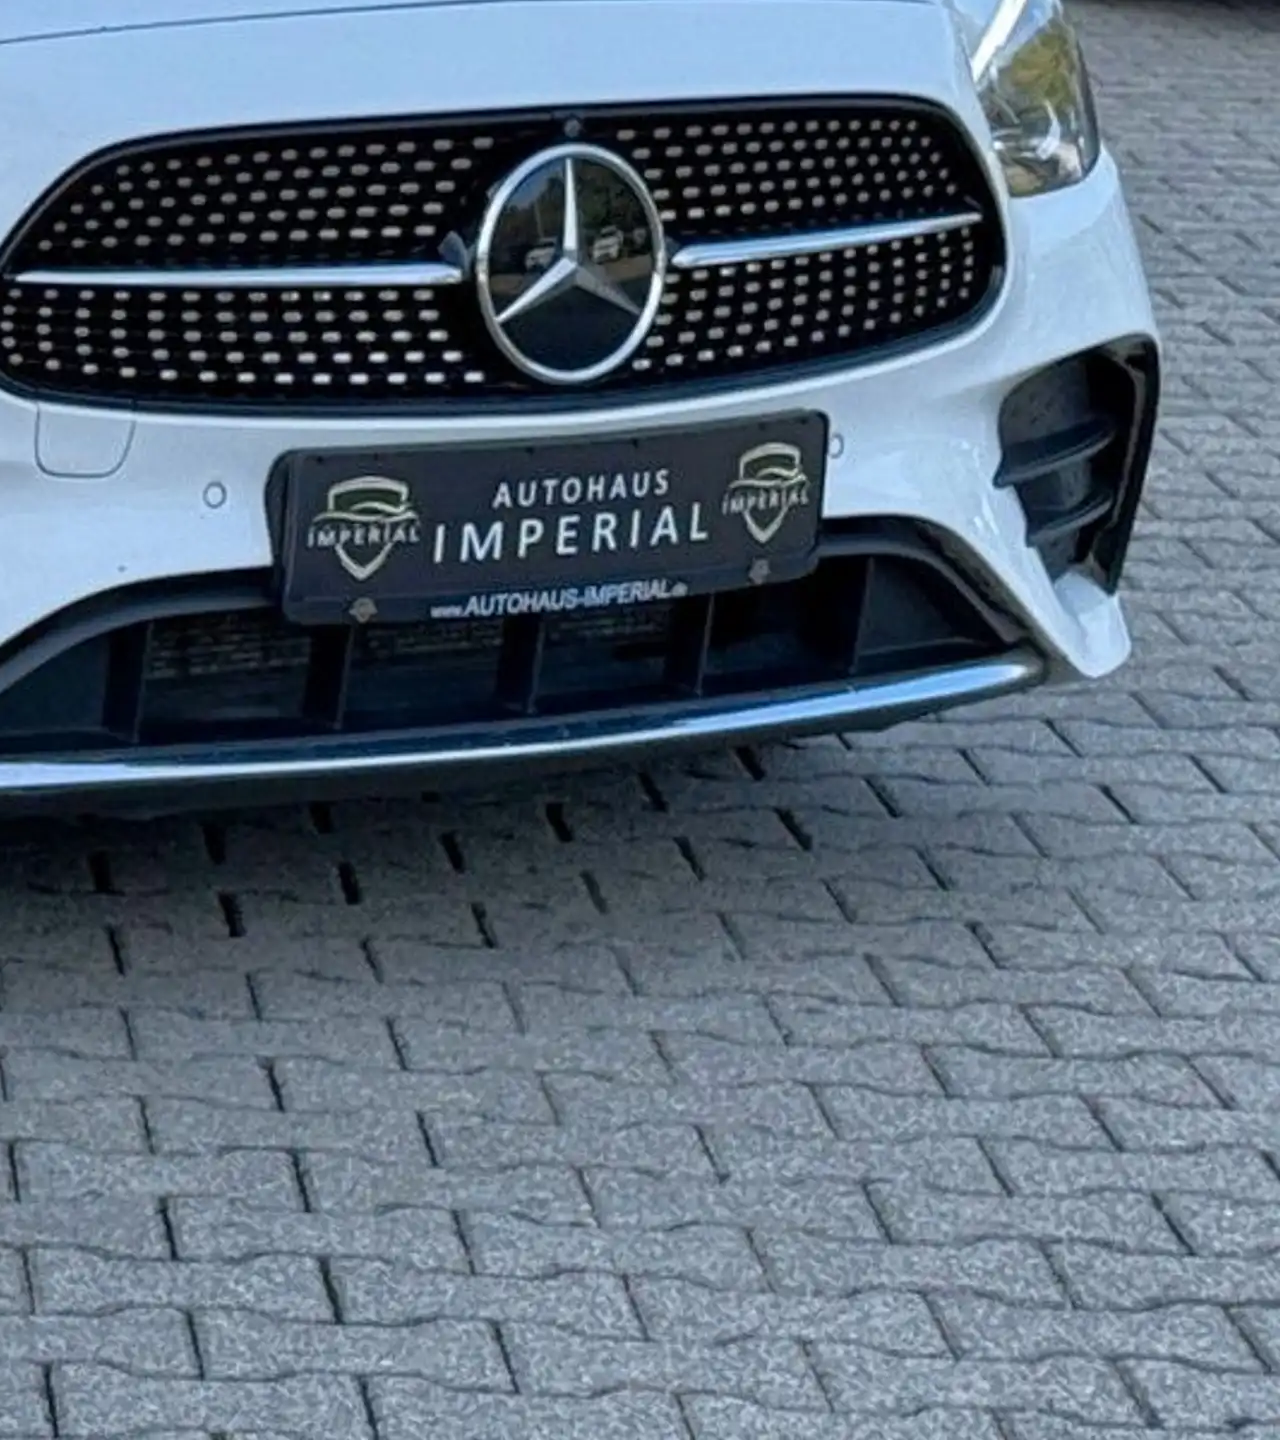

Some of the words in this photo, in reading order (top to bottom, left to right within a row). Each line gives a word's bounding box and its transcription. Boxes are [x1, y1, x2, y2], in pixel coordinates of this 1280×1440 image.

[492, 468, 670, 509] AUTOHAUS
[722, 477, 810, 516] IMPERIAL
[307, 520, 421, 548] IMPERIAL
[433, 502, 709, 563] IMPERIAL
